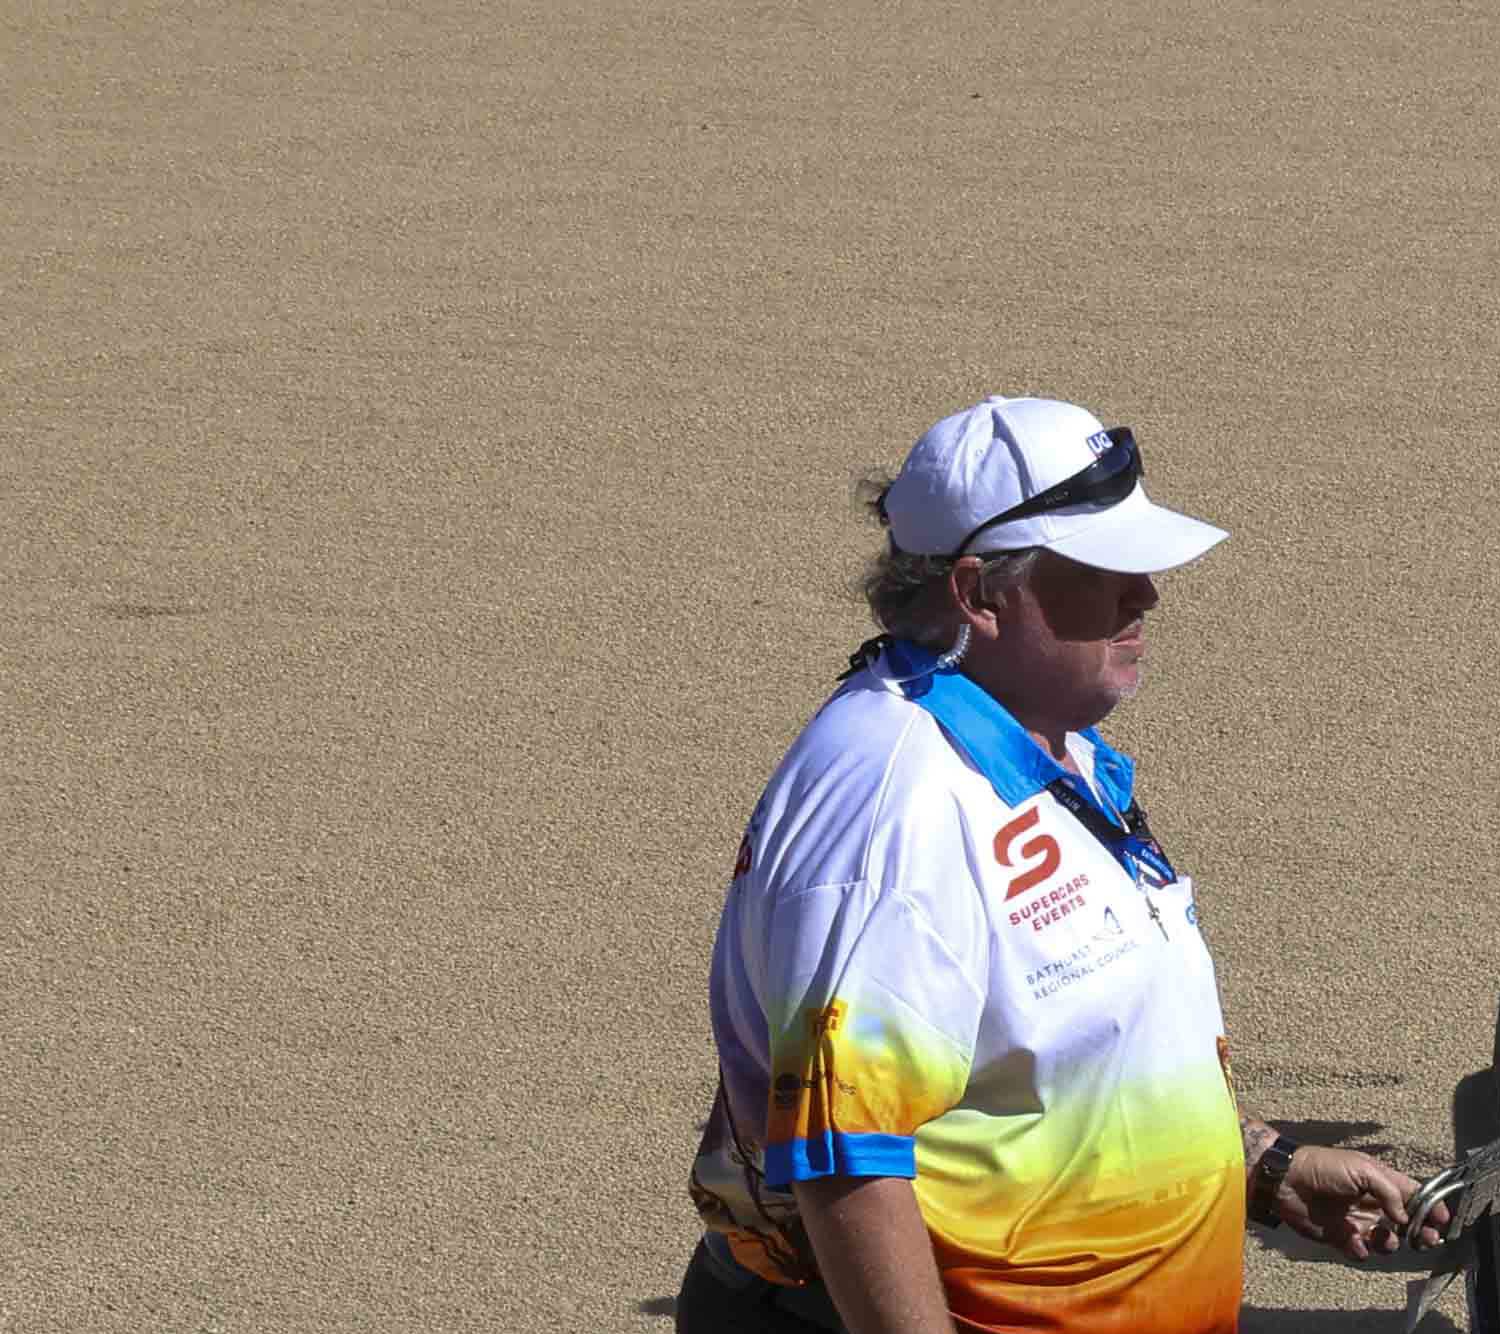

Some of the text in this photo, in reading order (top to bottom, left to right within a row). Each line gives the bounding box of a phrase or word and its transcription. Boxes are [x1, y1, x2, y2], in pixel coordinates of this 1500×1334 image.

[1008, 873, 1089, 927] SUPERCARS
[1032, 895, 1086, 932] EVENTS
[1026, 944, 1092, 986] BATHURST
